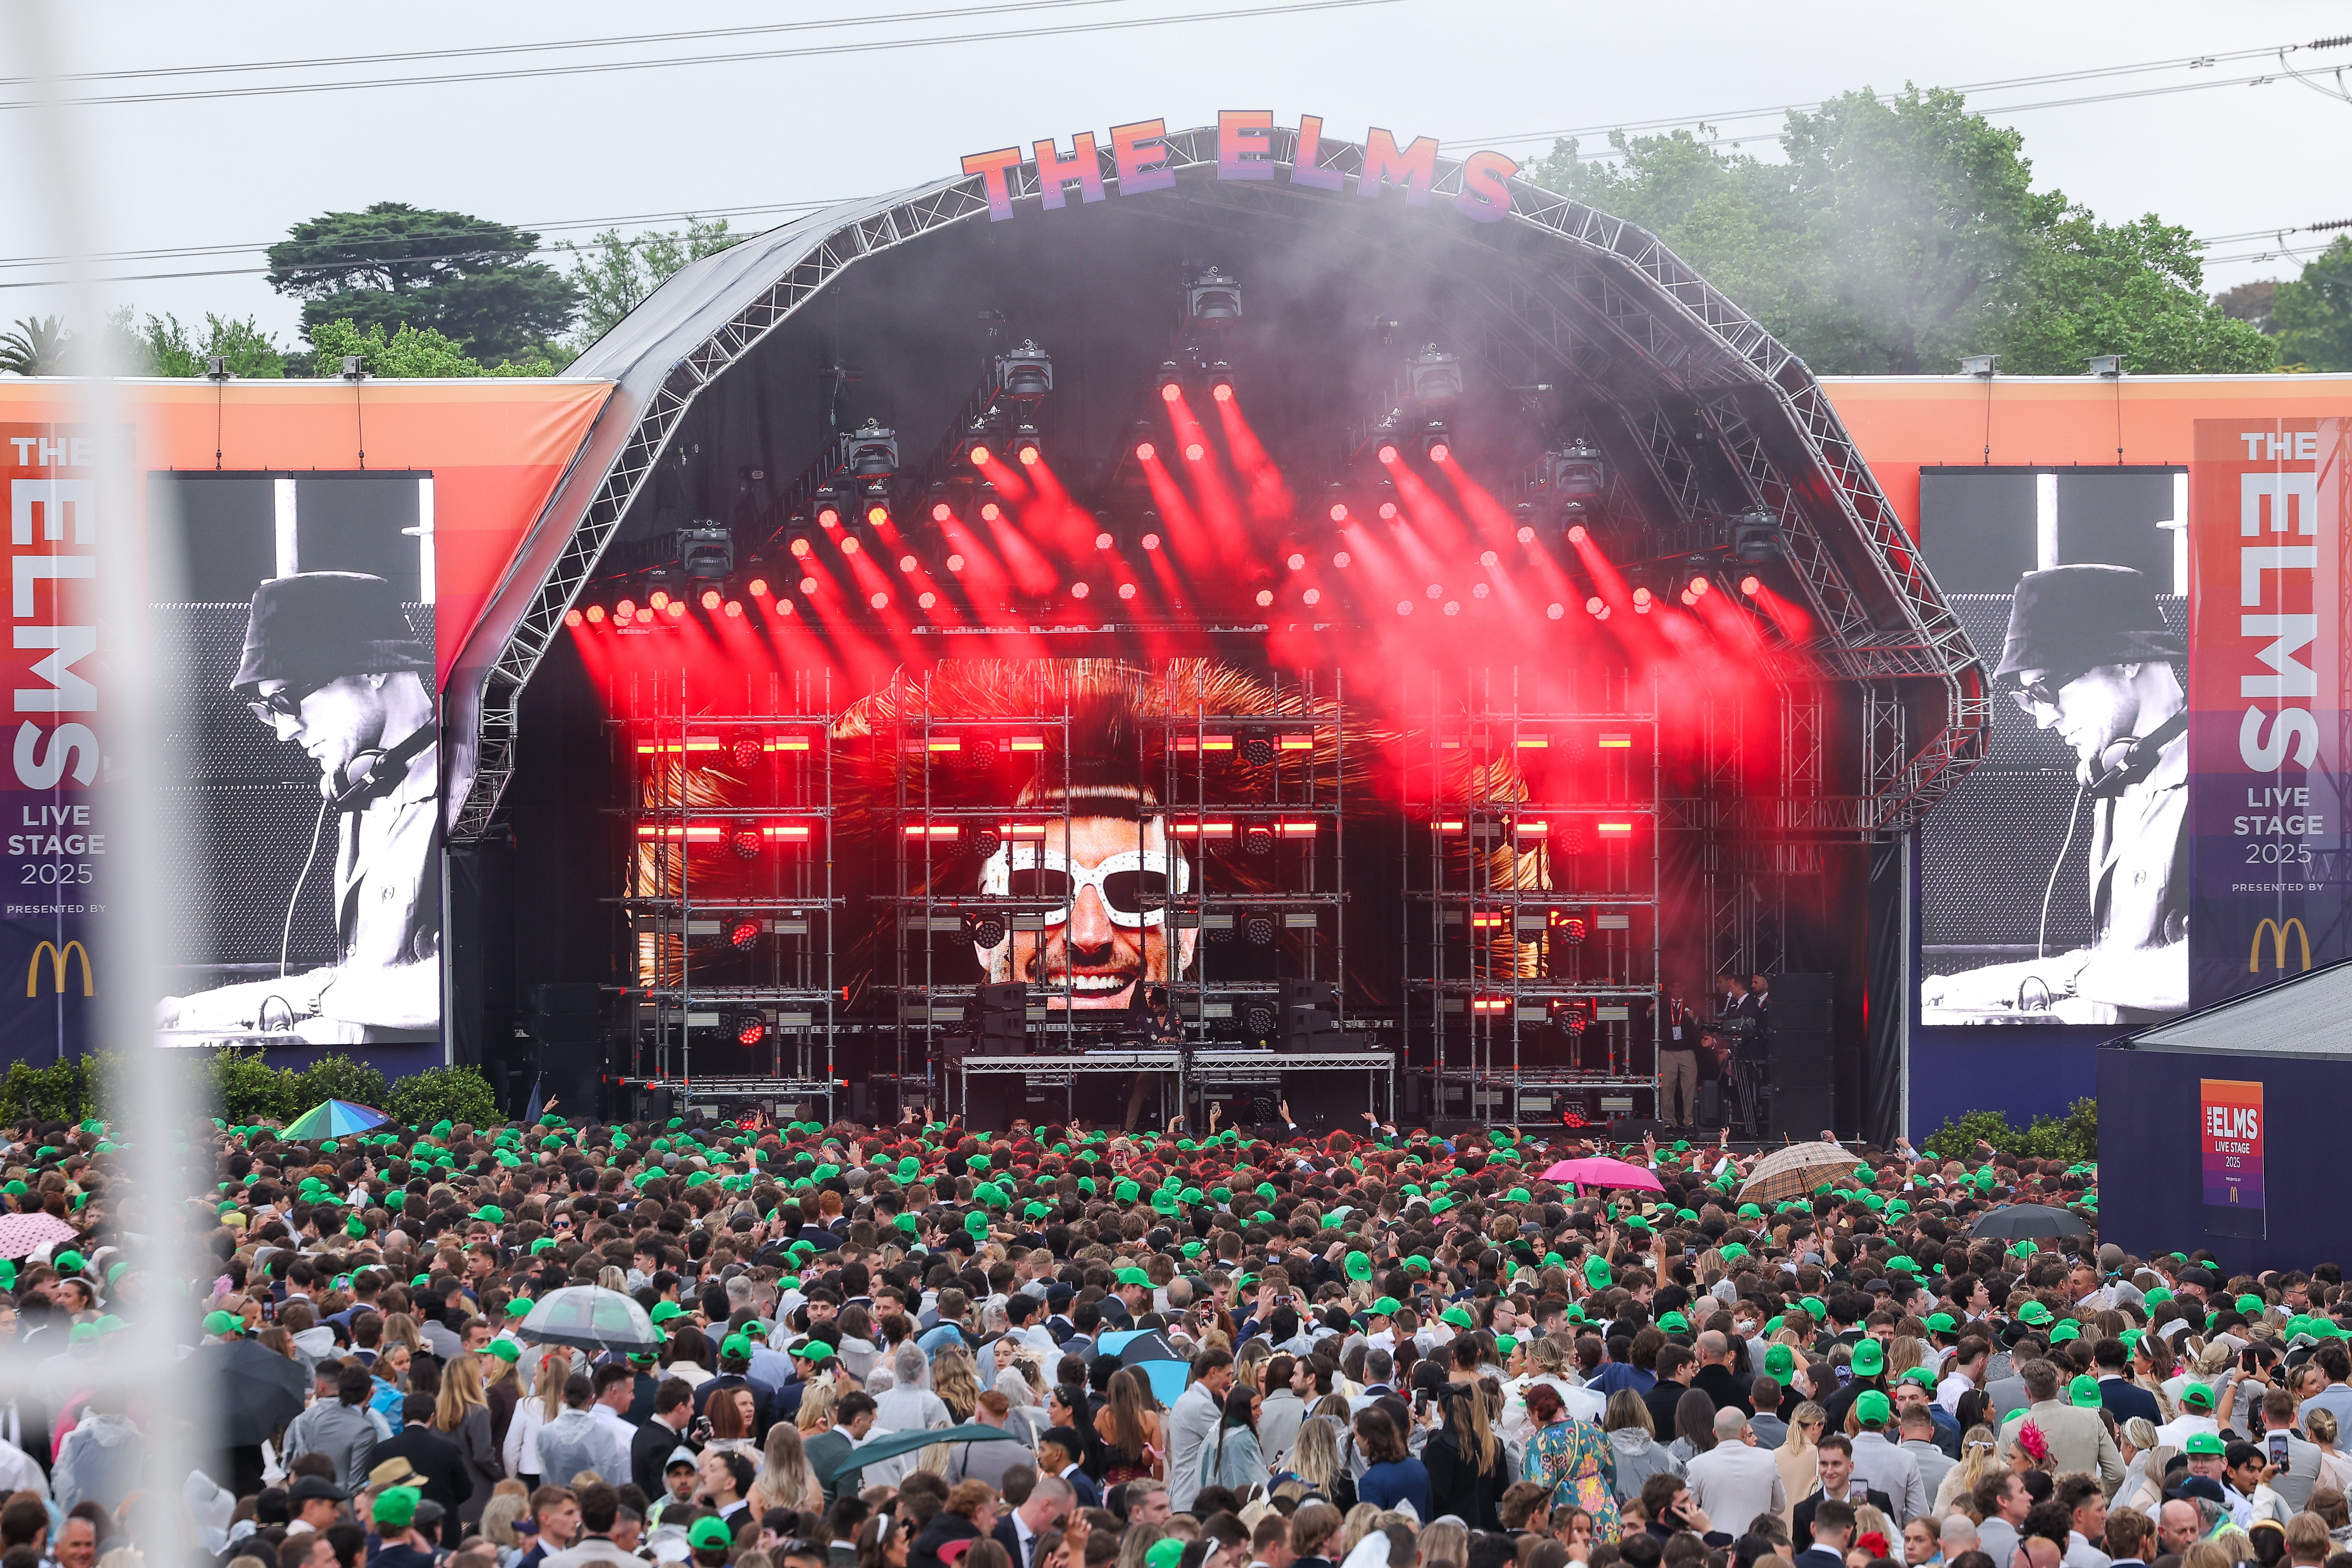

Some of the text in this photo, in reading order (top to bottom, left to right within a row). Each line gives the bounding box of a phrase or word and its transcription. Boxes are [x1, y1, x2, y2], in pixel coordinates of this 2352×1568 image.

[961, 110, 1521, 223] THE ELMS
[10, 437, 95, 466] THE
[2240, 432, 2318, 461] THE
[2239, 472, 2320, 773] ELMS
[10, 479, 99, 790] ELMS
[2247, 787, 2310, 807] LIVE
[23, 805, 91, 826] LIVE
[2233, 815, 2323, 835] STAGE
[8, 834, 106, 855] STAGE
[2245, 844, 2312, 864] 2025
[21, 864, 93, 884] 2025
[2232, 883, 2304, 892] PRESENTED
[7, 904, 107, 914] PRESENTED BY
[2213, 1106, 2258, 1139] ELMS
[2215, 1141, 2250, 1154] LIVE STAGE
[2226, 1156, 2240, 1168] 2025
